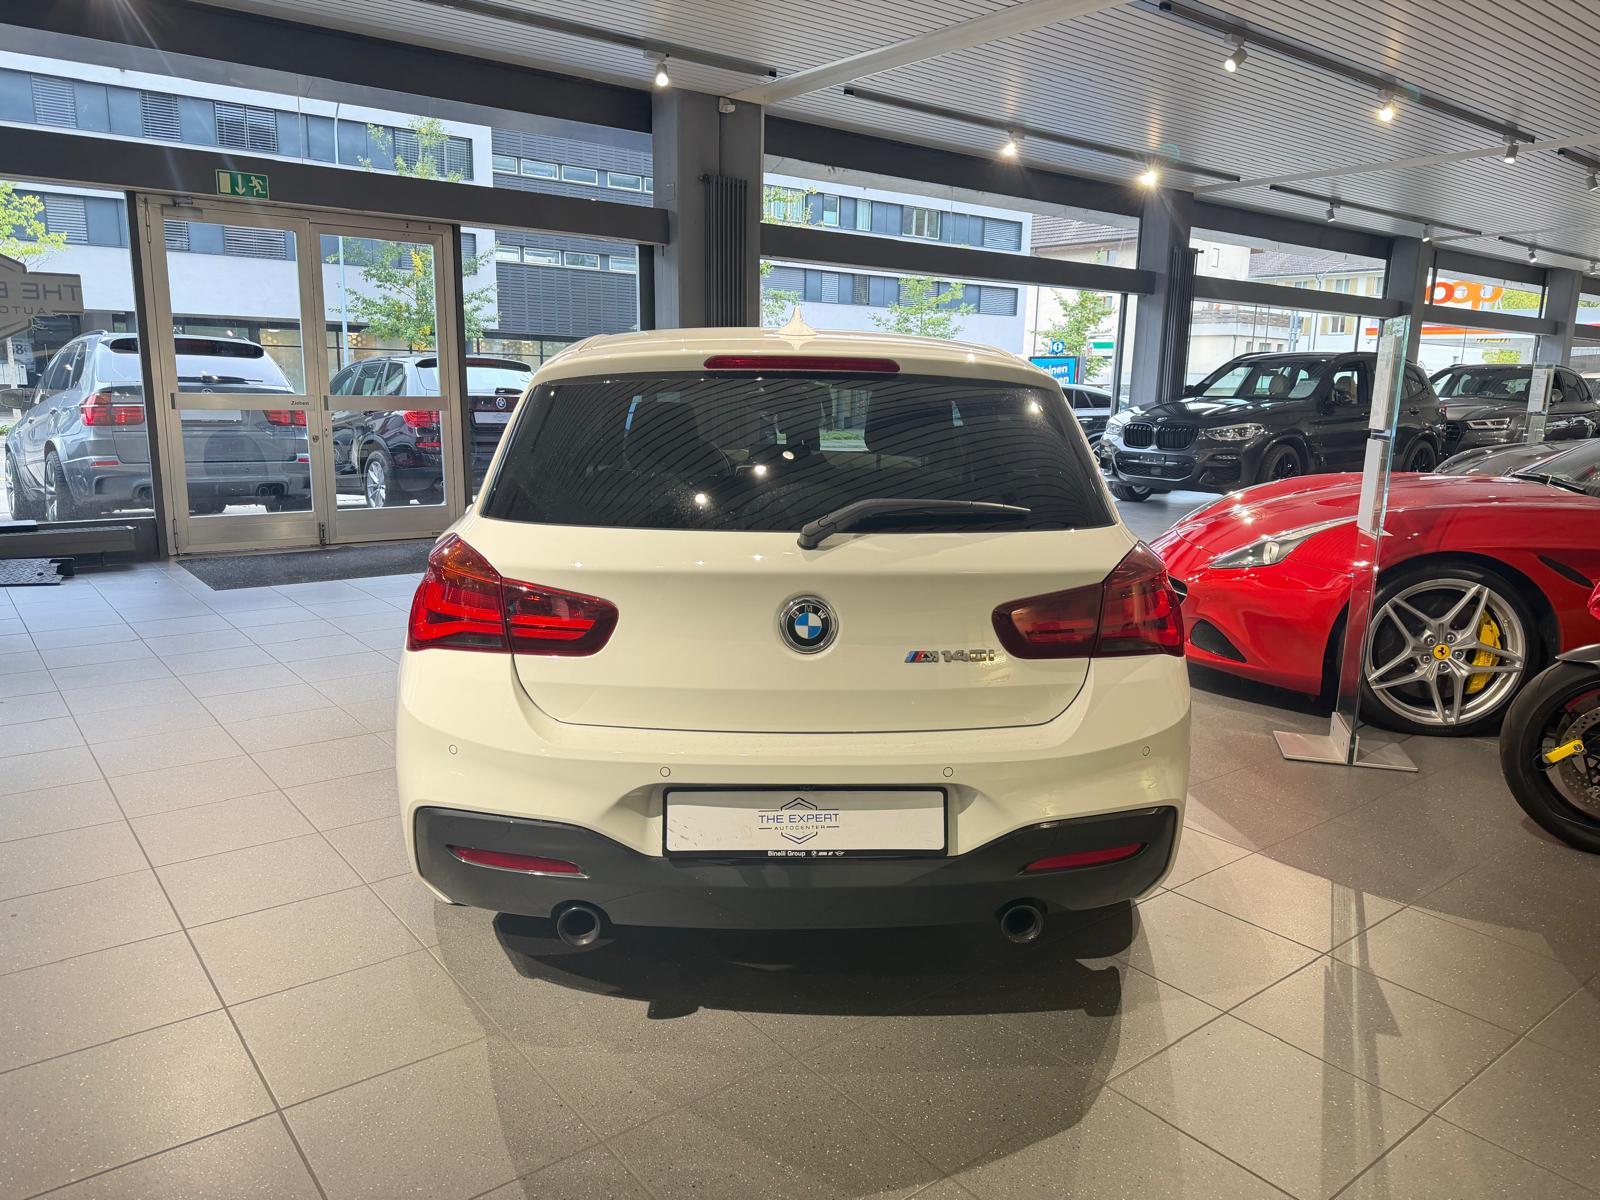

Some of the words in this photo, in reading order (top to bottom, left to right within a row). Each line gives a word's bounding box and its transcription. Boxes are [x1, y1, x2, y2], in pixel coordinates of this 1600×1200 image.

[1425, 282, 1504, 310] oop
[790, 604, 827, 619] BMW
[758, 815, 784, 823] THE
[789, 813, 840, 823] EXPERT
[787, 850, 806, 858] Group
